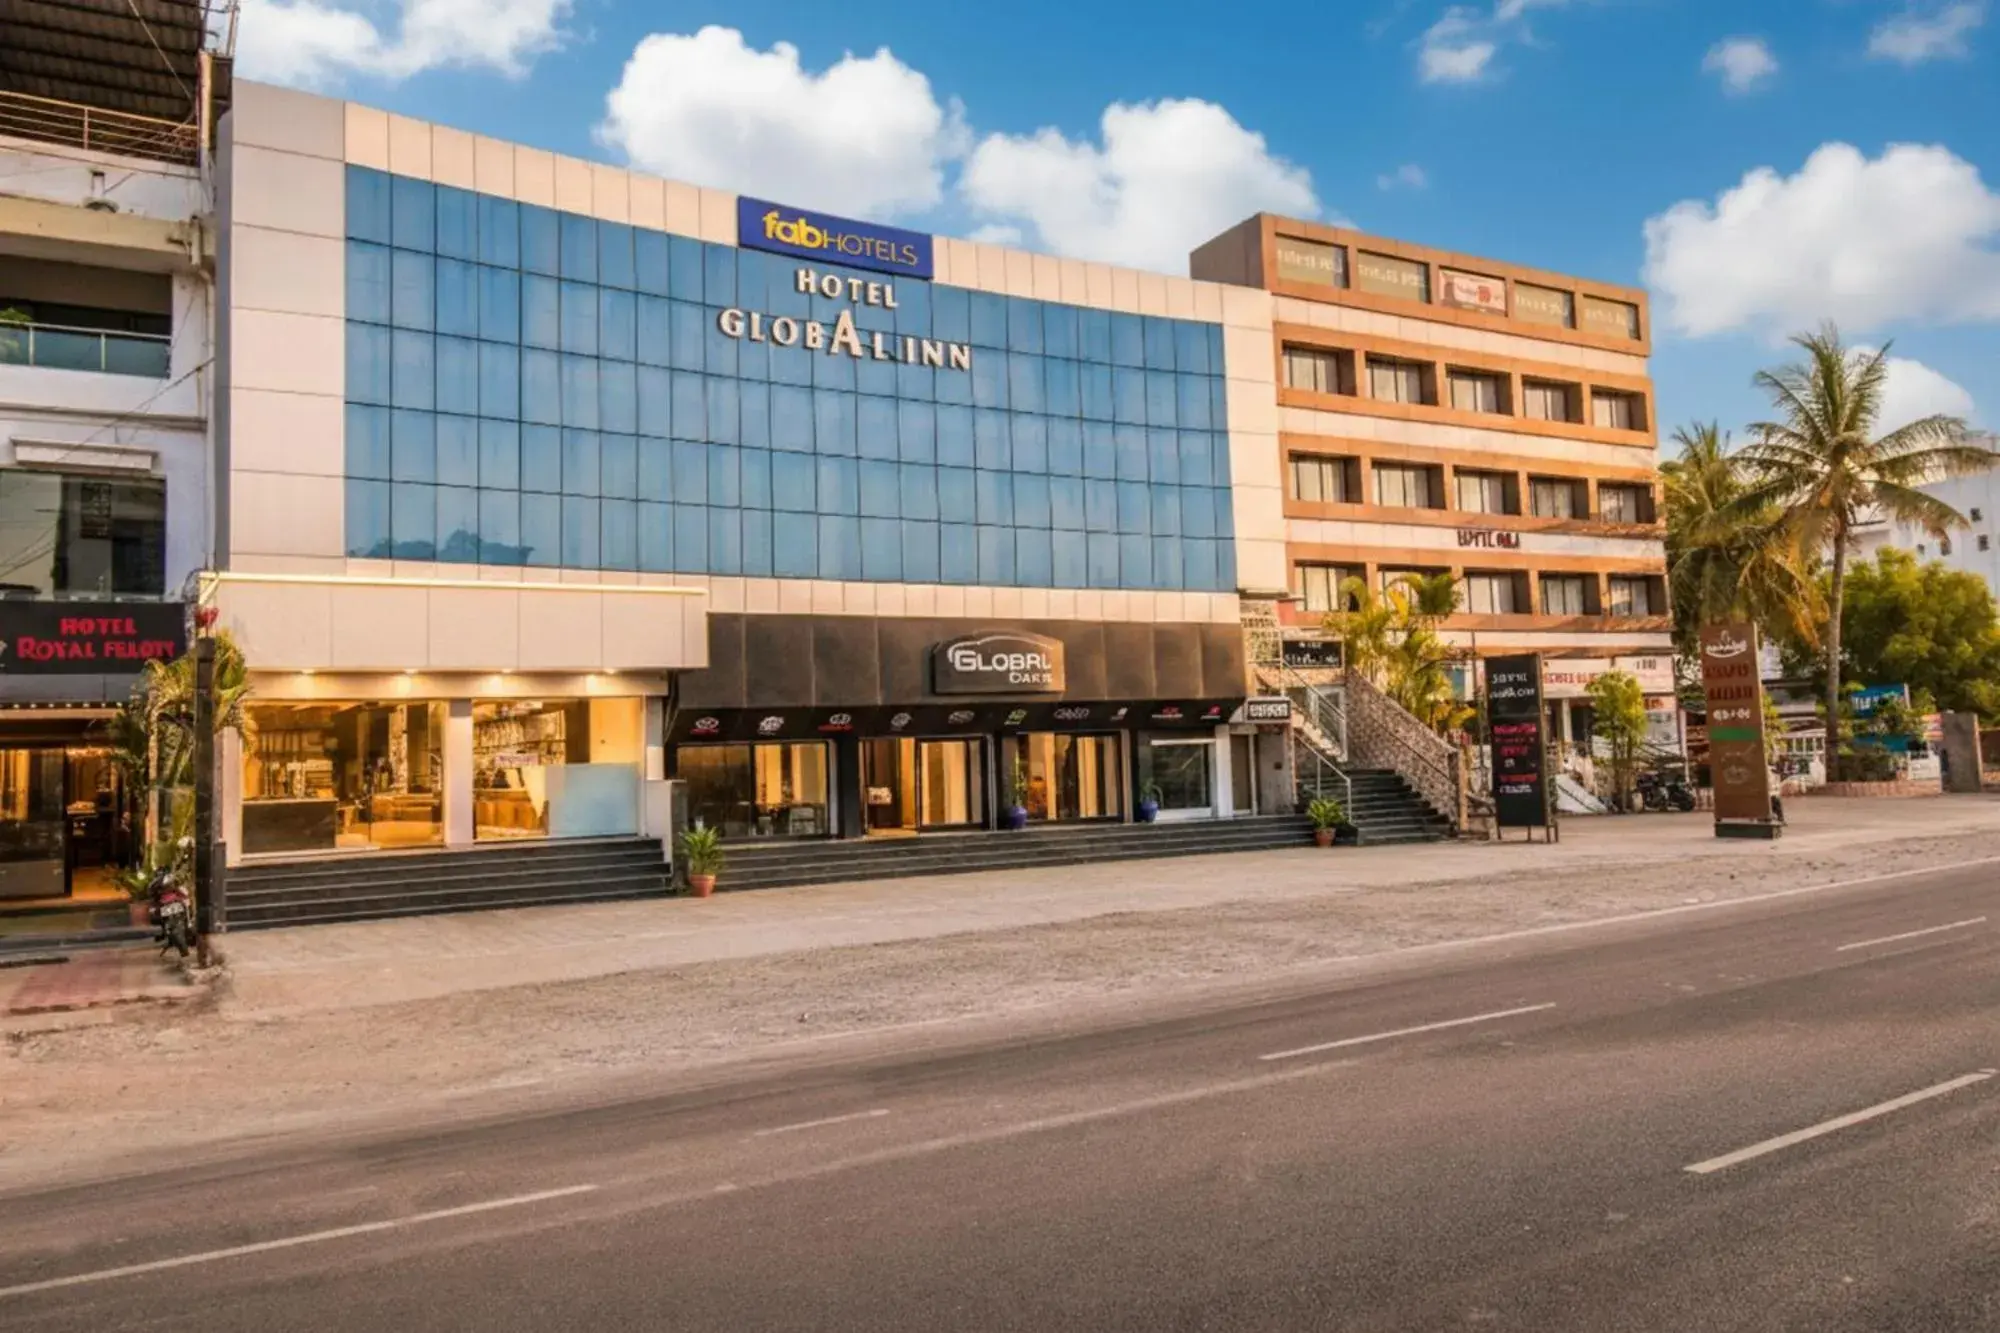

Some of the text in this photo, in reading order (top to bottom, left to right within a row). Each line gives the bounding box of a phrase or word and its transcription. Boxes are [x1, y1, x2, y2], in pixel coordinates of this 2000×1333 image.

[796, 268, 899, 309] HOTEL
[718, 308, 971, 371] GLOBAL INN
[60, 617, 138, 636] HOTEL
[17, 636, 96, 661] ROYAL
